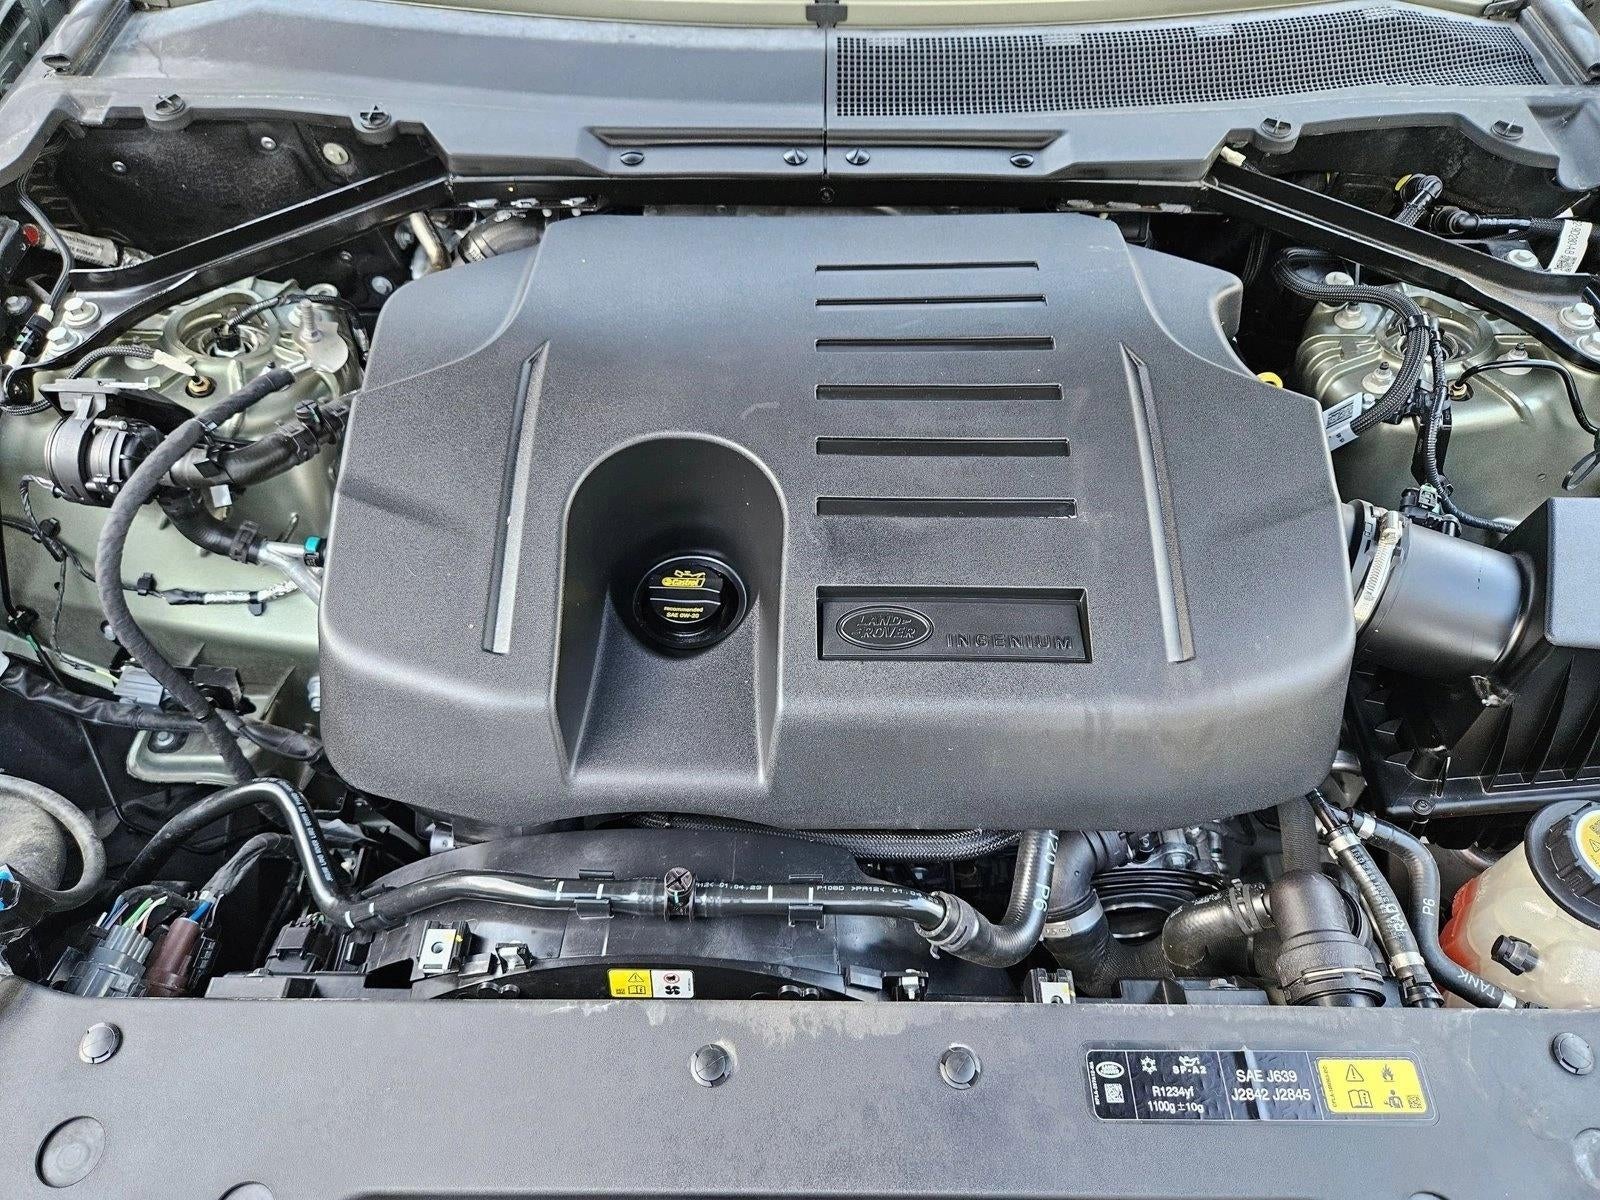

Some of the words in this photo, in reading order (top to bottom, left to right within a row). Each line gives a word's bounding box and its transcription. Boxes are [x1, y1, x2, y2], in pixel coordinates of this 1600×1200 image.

[946, 634, 1074, 650] INGENIUM
[1033, 883, 1051, 912] P6
[1422, 898, 1436, 916] P6
[1386, 903, 1408, 932] RAD
[1457, 968, 1496, 1000] TANK
[1235, 1069, 1265, 1082] SAE
[1266, 1069, 1298, 1083] J639
[1152, 1085, 1195, 1100] R1234yf
[1231, 1088, 1269, 1101] J2842
[1272, 1088, 1312, 1101] J2845
[1147, 1101, 1177, 1114] 1100g
